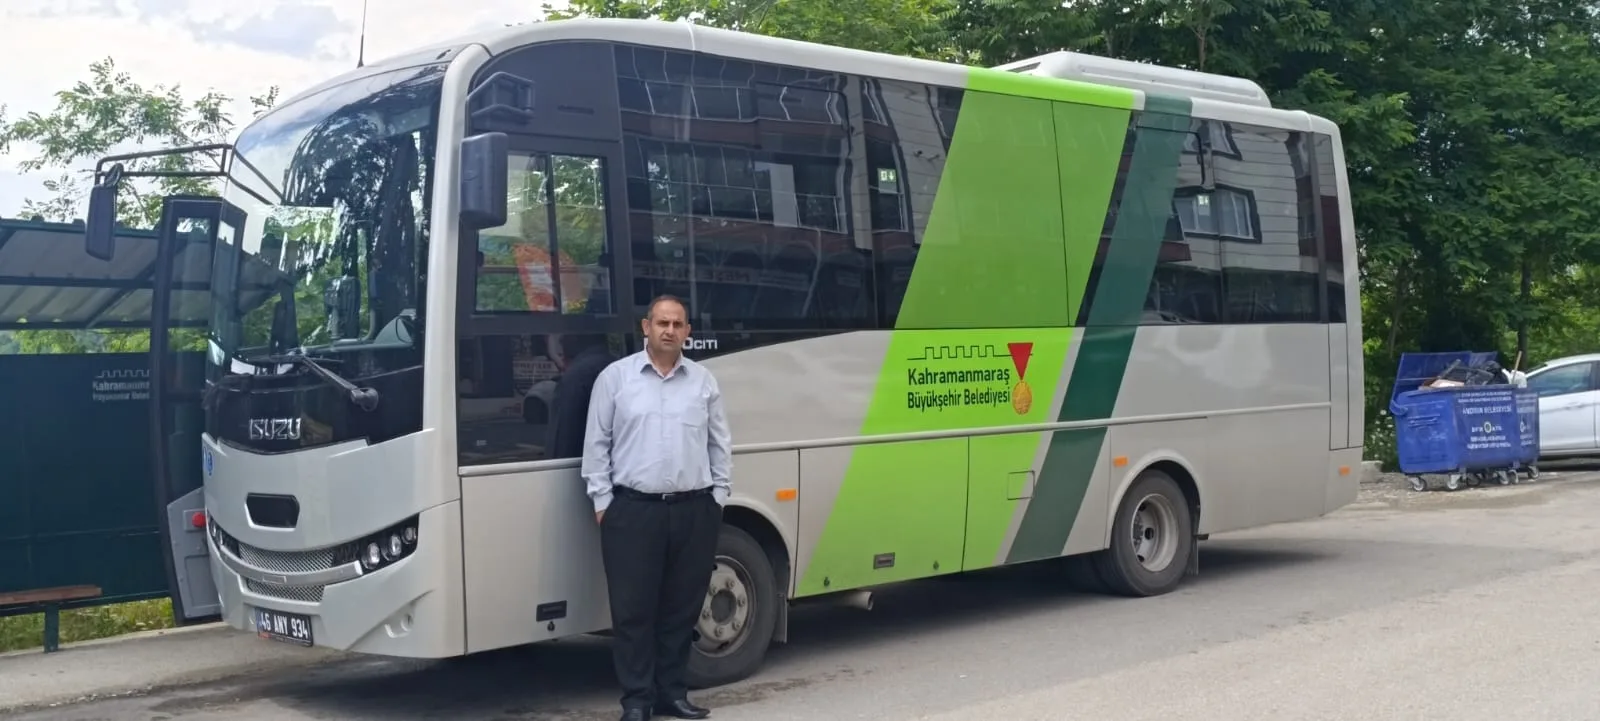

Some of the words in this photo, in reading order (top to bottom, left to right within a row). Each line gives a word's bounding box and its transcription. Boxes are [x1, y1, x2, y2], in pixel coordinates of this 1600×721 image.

[908, 368, 1010, 385] Kahramanmaraş
[908, 389, 962, 412] Büyükşehir
[964, 387, 1010, 407] Belediyesi
[250, 418, 301, 439] ISUZU
[260, 611, 271, 631] 46
[274, 614, 288, 635] ANY
[291, 617, 308, 639] 934
